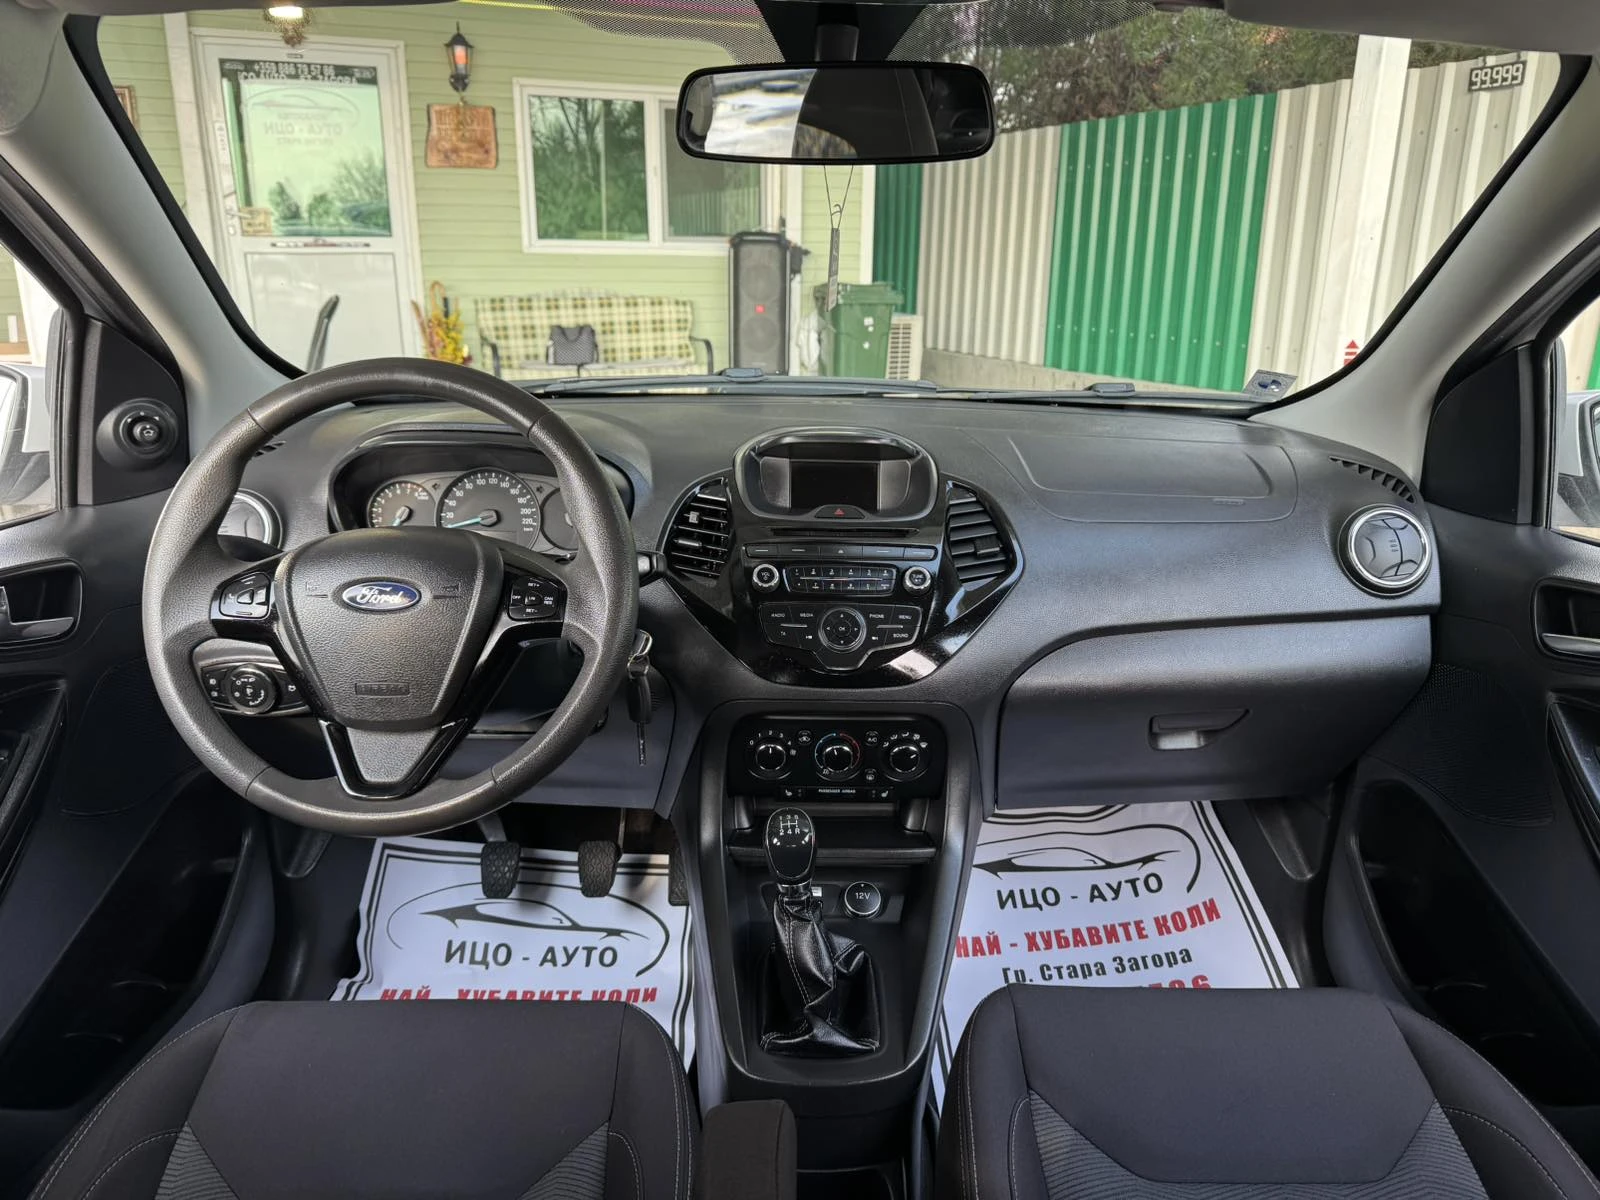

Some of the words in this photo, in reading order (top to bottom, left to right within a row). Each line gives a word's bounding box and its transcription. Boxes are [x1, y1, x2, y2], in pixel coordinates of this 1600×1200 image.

[1471, 64, 1523, 89] 99.999
[500, 481, 510, 489] 140
[356, 586, 404, 604] Ford
[855, 892, 871, 900] 12V
[997, 886, 1061, 911] ИЦО
[1089, 872, 1163, 903] АУТО
[956, 931, 1002, 958] НАЙ
[1024, 919, 1149, 952] ХУБАВИТЕ
[1153, 897, 1221, 936] КОЛИ
[445, 940, 513, 970] ИЦО
[539, 946, 618, 968] АУТО
[1039, 960, 1107, 981] Стара
[1112, 948, 1193, 974] Загора
